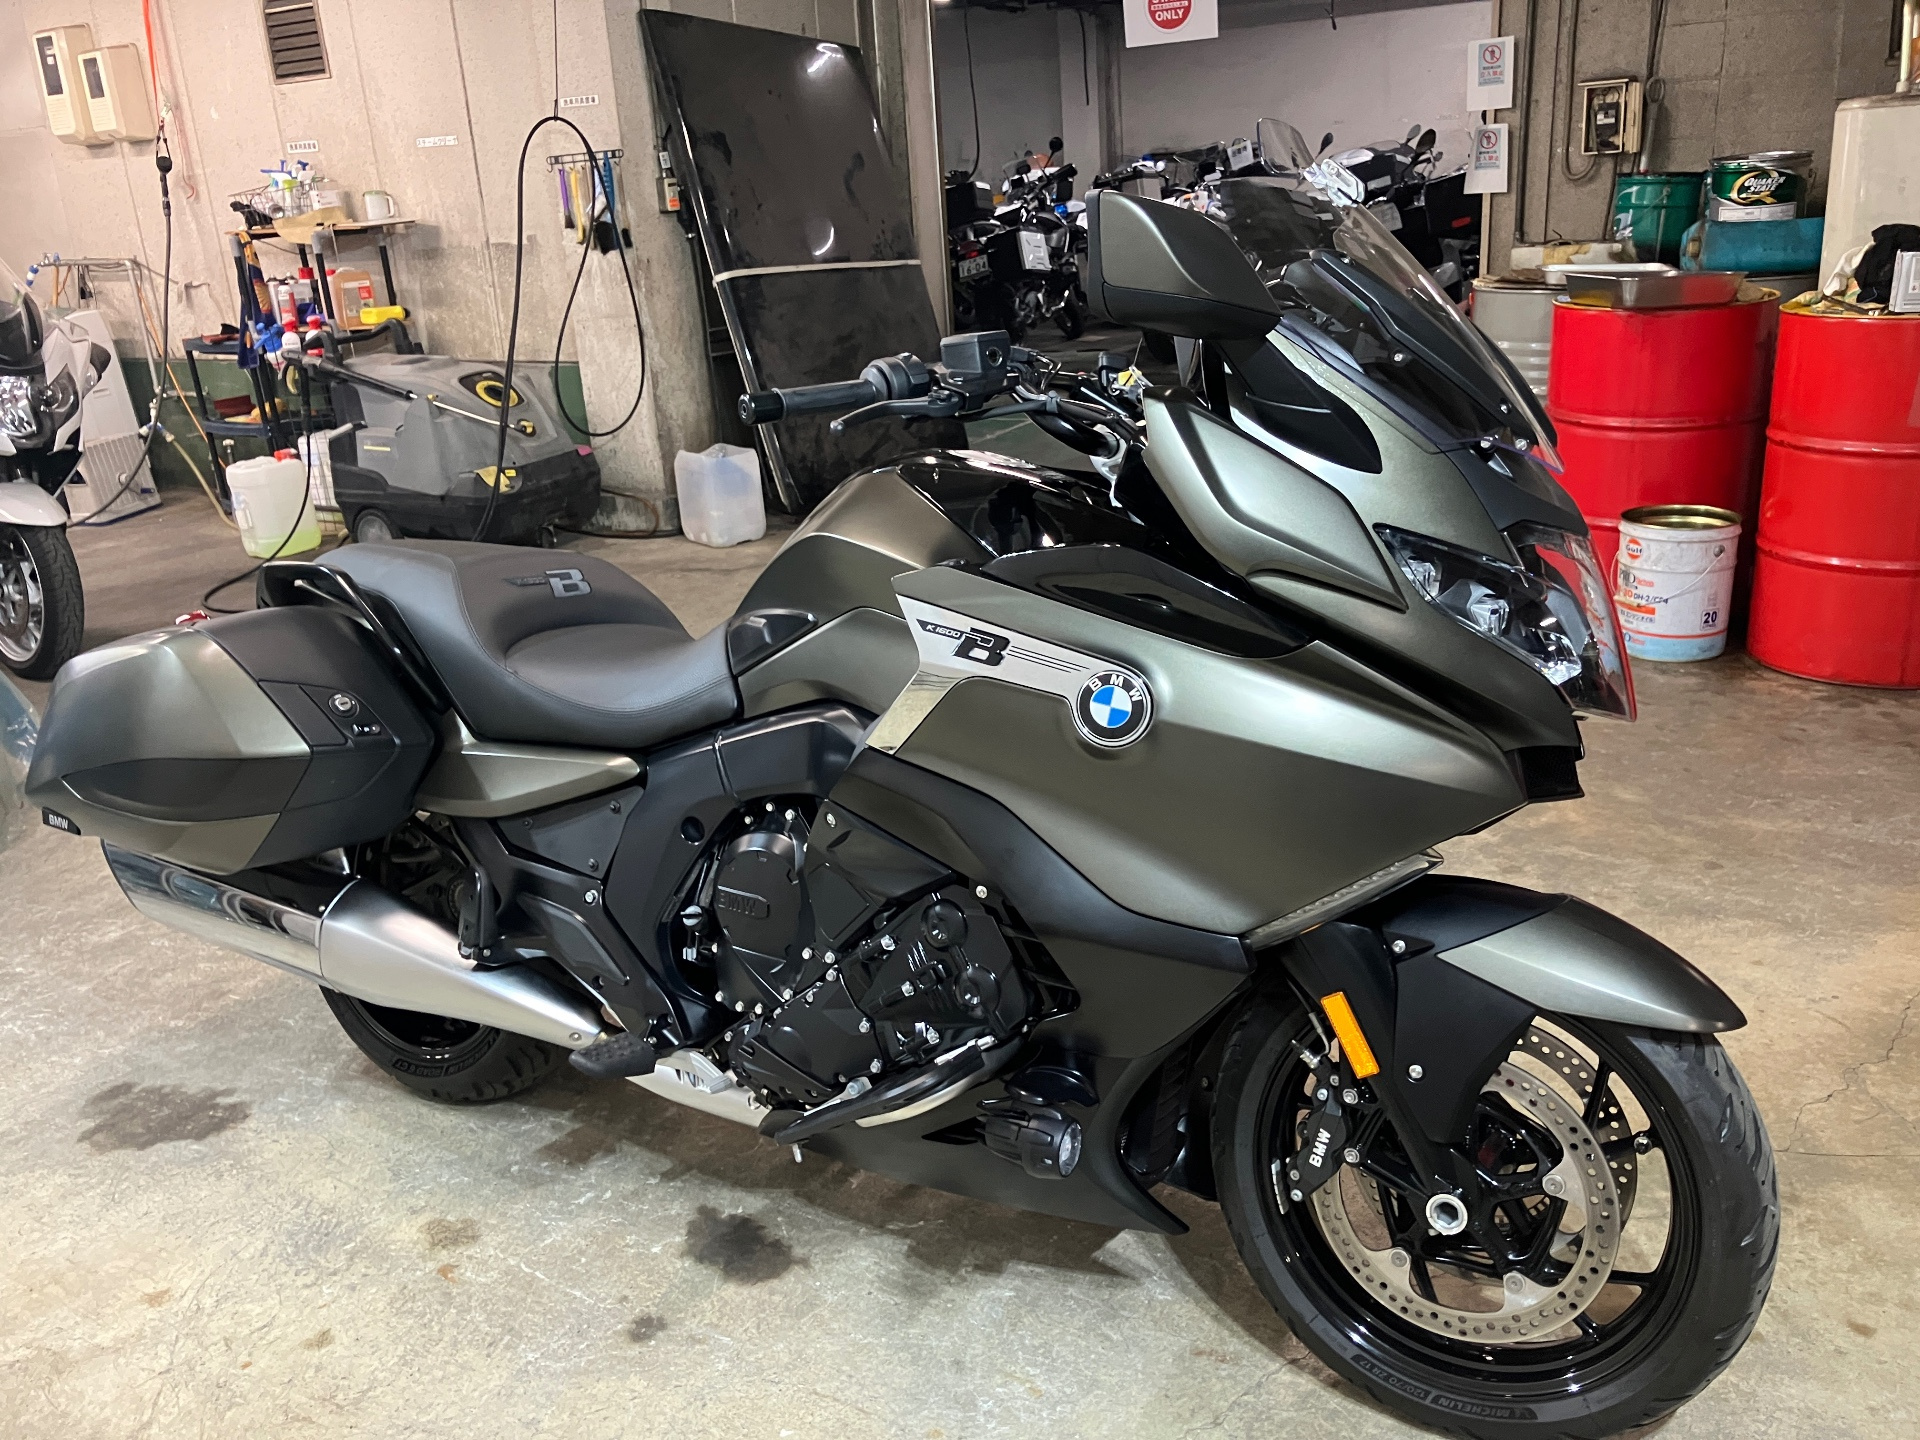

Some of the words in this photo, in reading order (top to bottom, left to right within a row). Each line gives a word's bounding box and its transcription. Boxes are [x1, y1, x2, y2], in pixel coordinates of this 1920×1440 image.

[1155, 8, 1185, 21] ONLY
[1744, 176, 1786, 187] QUAKER
[1747, 183, 1778, 193] STATE
[1703, 611, 1718, 624] 20
[1089, 673, 1143, 702] BMW
[49, 813, 69, 830] BMW
[719, 892, 757, 916] BMW
[1309, 1127, 1331, 1168] BMW
[1359, 1358, 1372, 1369] 17
[1372, 1366, 1388, 1380] ZR
[1389, 1377, 1426, 1400] 120/70
[1438, 1397, 1511, 1418] MICHELIN
